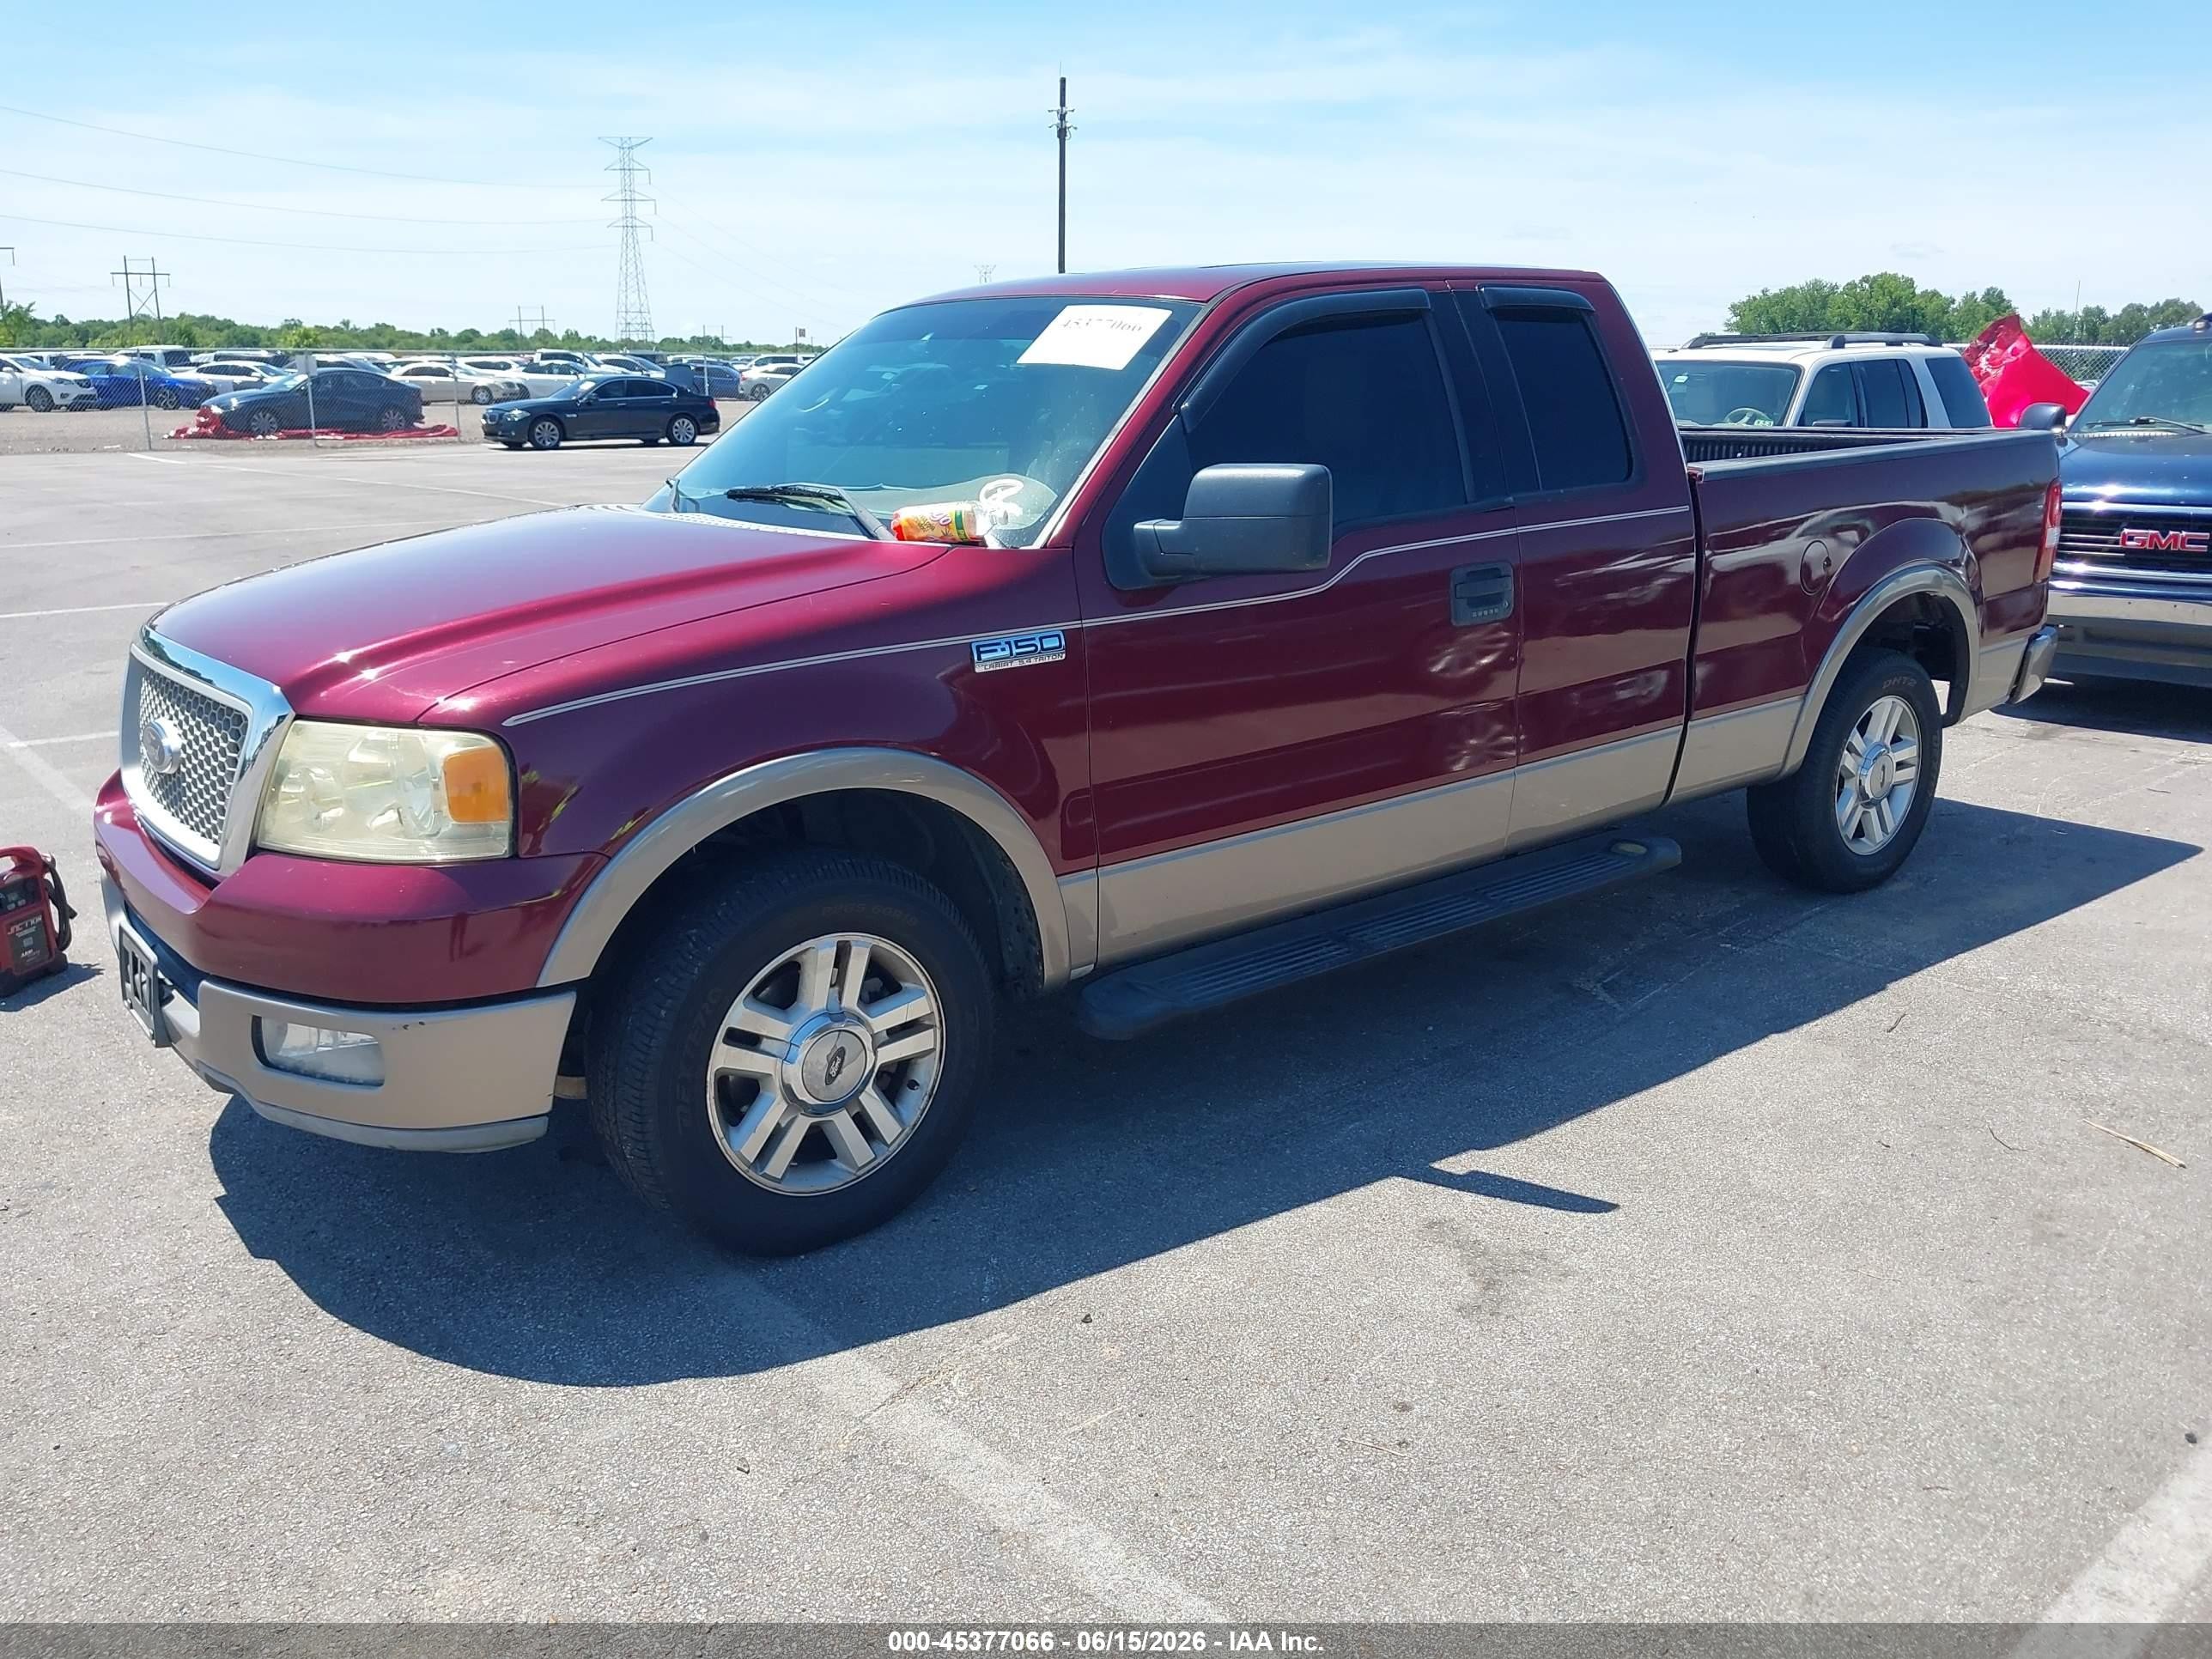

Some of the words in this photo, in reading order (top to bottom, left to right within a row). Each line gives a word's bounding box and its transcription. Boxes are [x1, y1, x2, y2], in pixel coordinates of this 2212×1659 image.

[2120, 528, 2210, 552] GMC
[975, 633, 1063, 661] F-150
[1035, 653, 1063, 662] TRITON
